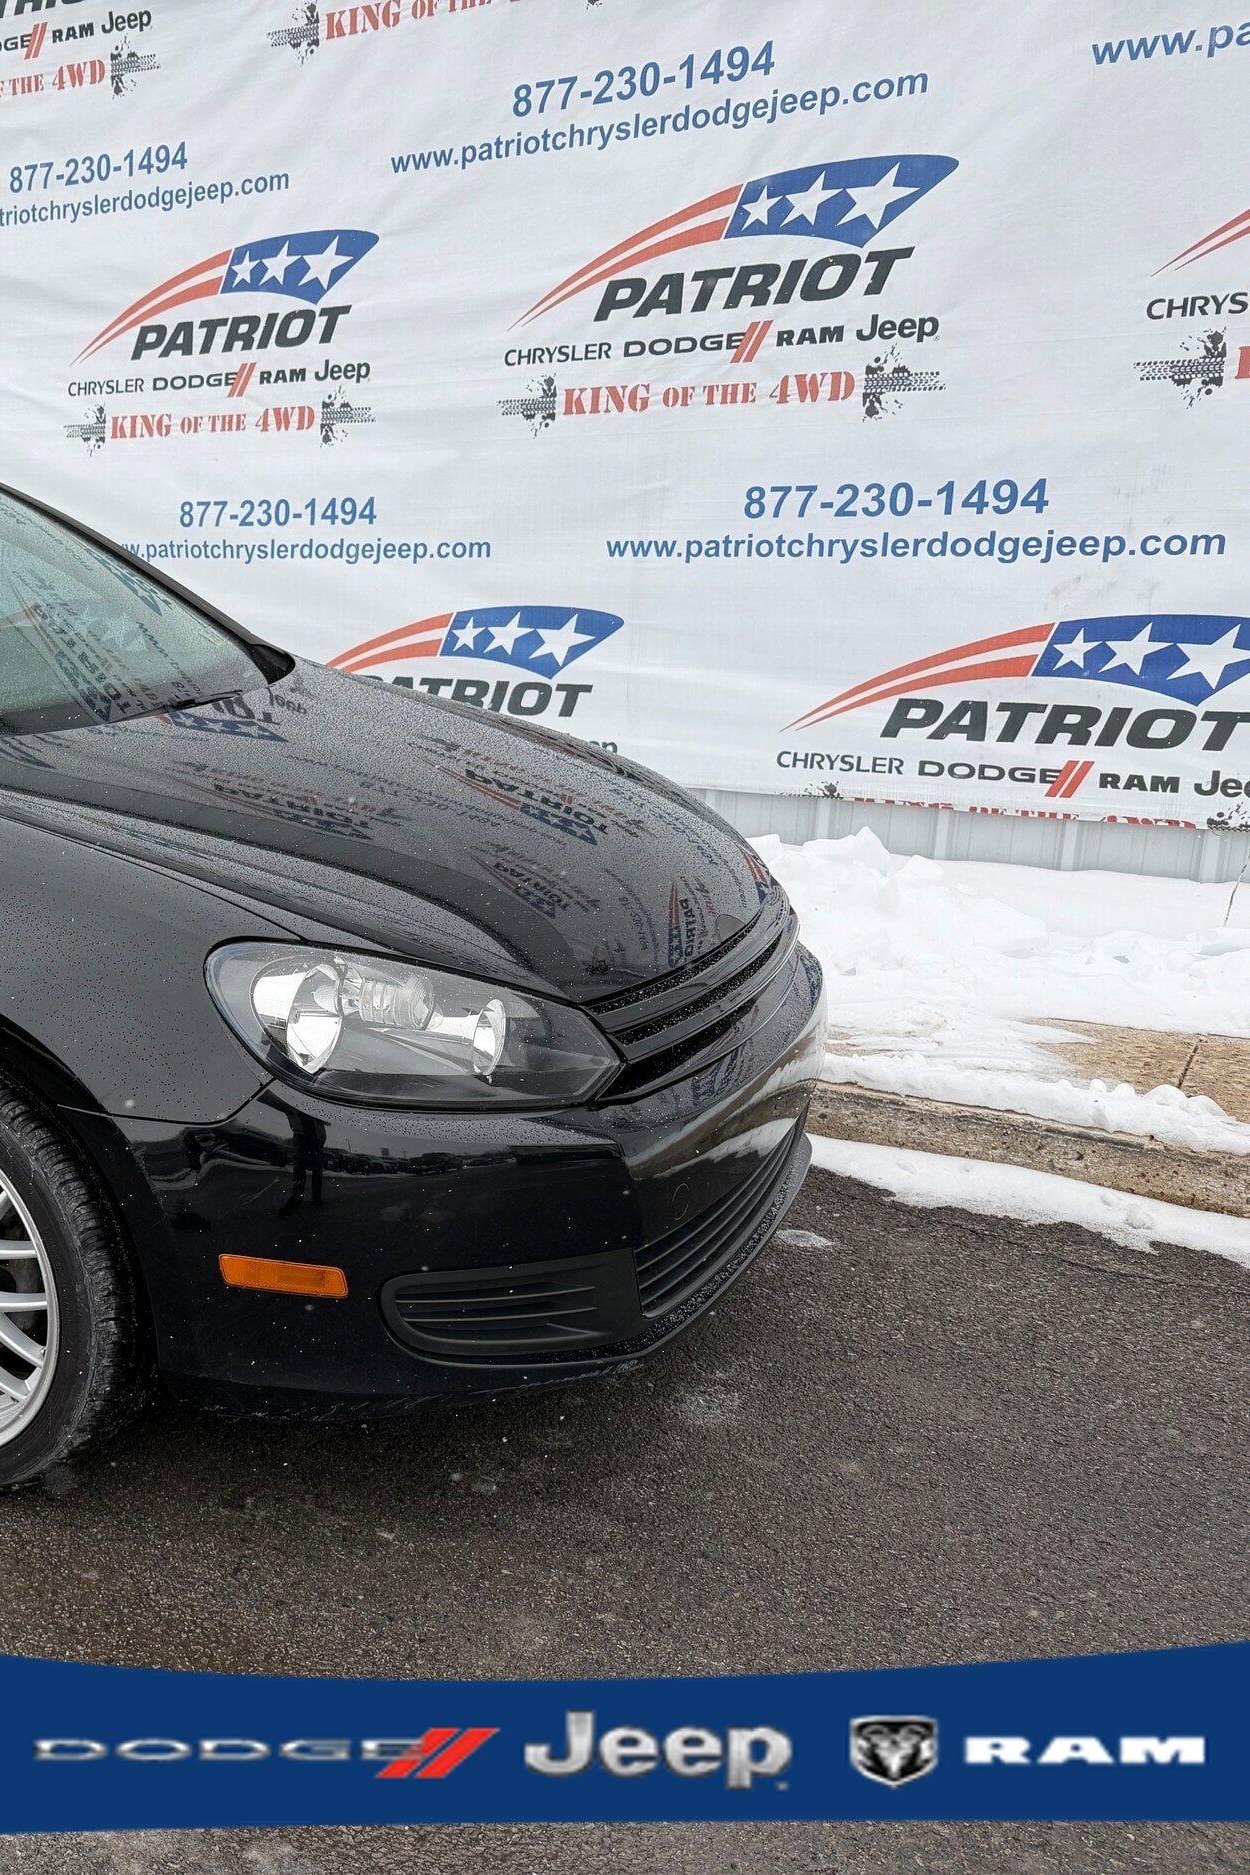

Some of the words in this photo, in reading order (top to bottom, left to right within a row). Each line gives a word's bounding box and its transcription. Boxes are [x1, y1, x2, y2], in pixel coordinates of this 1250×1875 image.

[52, 23, 95, 43] RAM
[101, 9, 152, 33] Jeep
[326, 0, 400, 39] KING
[8, 74, 44, 96] THE
[52, 60, 105, 91] 4WD
[511, 40, 776, 119] 877-230-1494
[391, 71, 930, 173] www.patriotchryslerdodgejeep.com
[9, 142, 188, 195] 877-230-1494
[593, 246, 915, 322] PATRIOT
[131, 305, 352, 361] PATRIOT
[504, 342, 612, 367] CHRYSLER
[623, 332, 746, 358] DODGE
[776, 324, 845, 347] RAM
[855, 313, 939, 343] Jeep
[68, 378, 144, 397] CHRYSLER
[152, 372, 238, 391] DODGE
[259, 368, 307, 385] RAM
[314, 359, 371, 384] Jeep
[564, 384, 651, 416] KING
[663, 386, 694, 407] OF
[702, 382, 757, 406] THE
[769, 371, 855, 404] 4WD
[111, 412, 172, 440] KING
[180, 416, 204, 434] OF
[208, 413, 246, 433] THE
[255, 405, 316, 432] 4WD
[179, 496, 377, 529] 877-230-1494
[744, 478, 1049, 521] 877-230-1494
[606, 529, 1227, 566] www.patriotchryslerdodgejeep.com
[358, 675, 594, 718] TRIOT
[880, 698, 1250, 751] PATRIOT
[777, 751, 904, 775] CHRYSLER
[917, 760, 1060, 785] DODGE
[1099, 773, 1180, 793] RAM
[1193, 770, 1250, 799] Je
